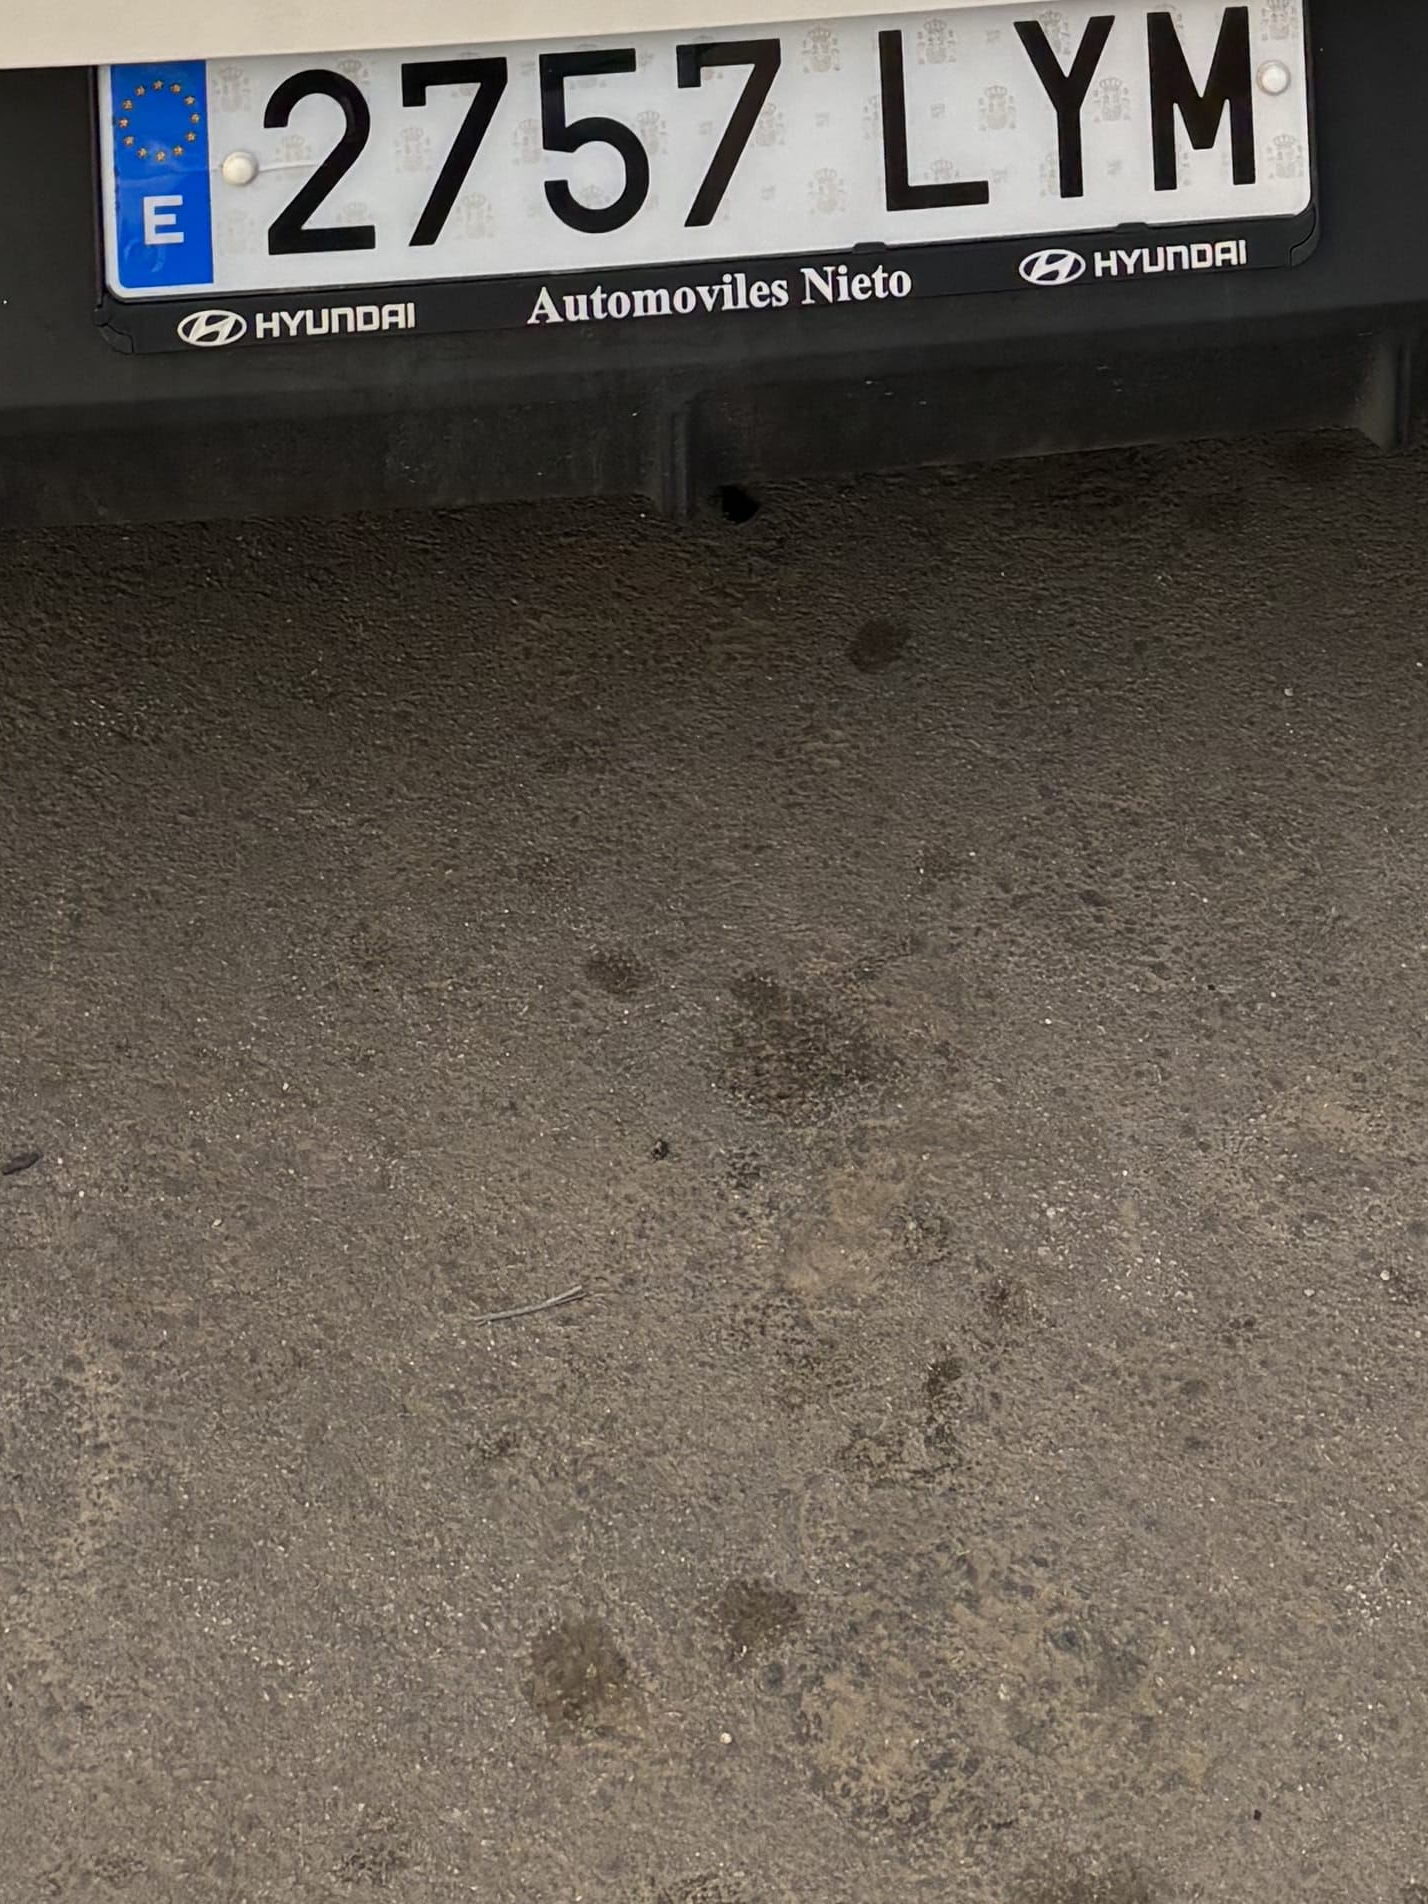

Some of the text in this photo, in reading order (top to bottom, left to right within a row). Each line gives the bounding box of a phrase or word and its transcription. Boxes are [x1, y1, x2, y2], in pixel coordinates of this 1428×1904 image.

[262, 5, 1258, 256] 2757 LYM
[143, 194, 184, 245] E
[1094, 239, 1247, 278] HYUNDAI
[255, 302, 416, 339] HYUNDAI
[527, 264, 914, 326] Automoviles Nieto
